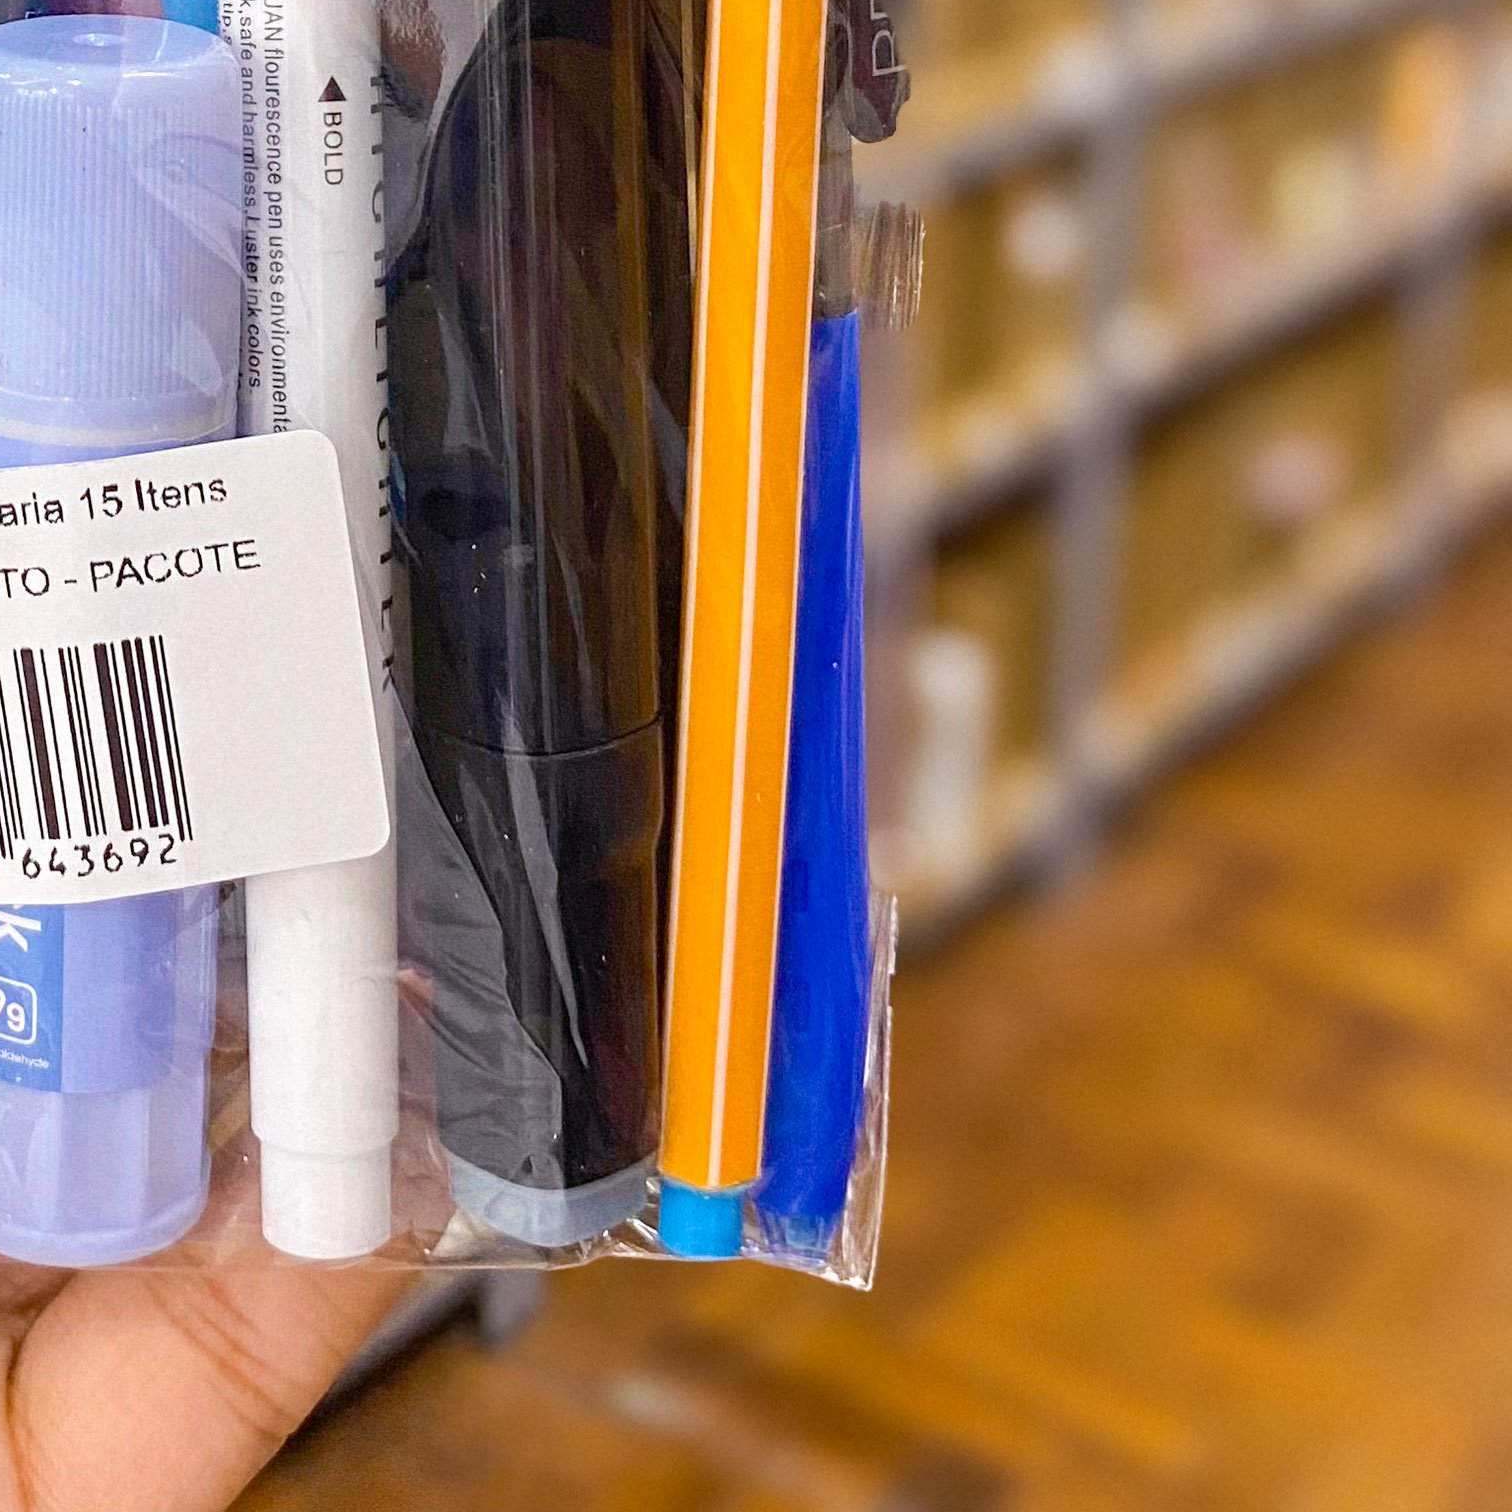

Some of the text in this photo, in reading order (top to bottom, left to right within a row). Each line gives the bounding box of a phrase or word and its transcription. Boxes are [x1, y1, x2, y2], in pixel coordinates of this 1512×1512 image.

[241, 66, 258, 103] and
[264, 48, 284, 186] flourescence
[323, 111, 344, 186] BOLD
[263, 189, 284, 229] pen
[268, 235, 285, 286] uses
[246, 287, 264, 318] ink
[79, 483, 124, 520] 15
[133, 475, 228, 513] Itens
[88, 538, 261, 593] PACOTE
[21, 832, 178, 880] 643692
